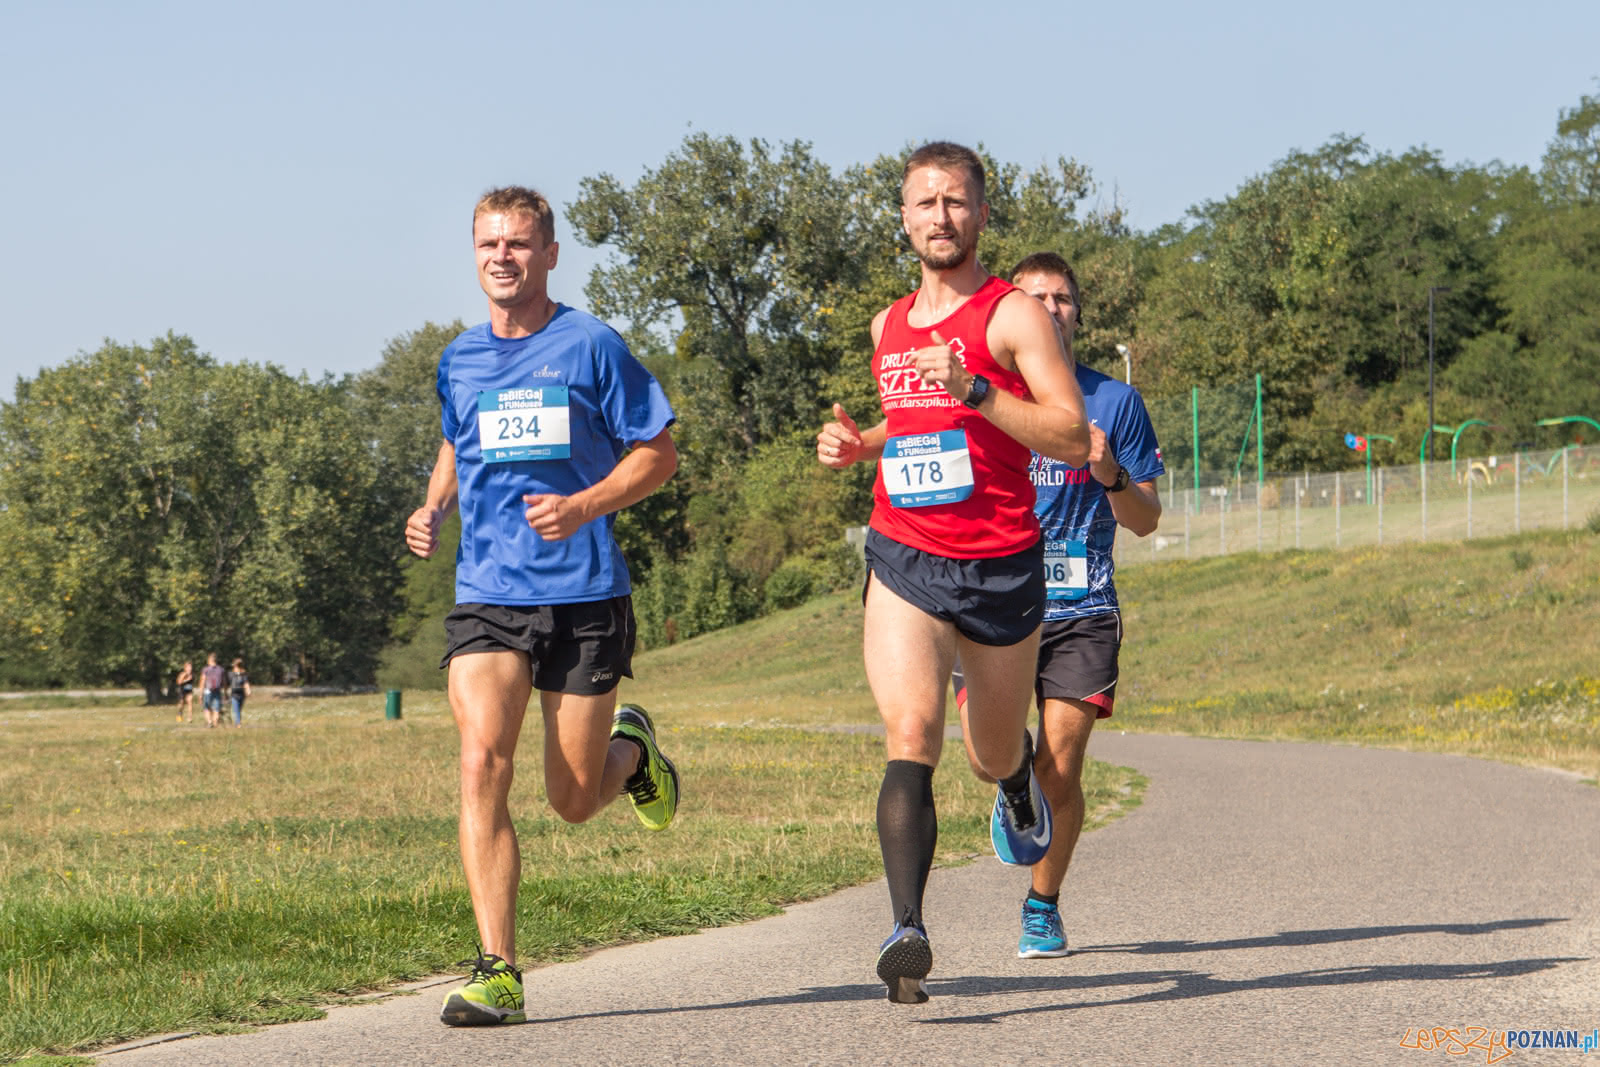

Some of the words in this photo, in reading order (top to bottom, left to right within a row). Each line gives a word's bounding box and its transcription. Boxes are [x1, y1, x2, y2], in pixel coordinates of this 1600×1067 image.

[498, 388, 543, 402] zaBIEGaj
[498, 415, 541, 440] 234
[896, 433, 941, 449] zaBIEGaj
[901, 461, 943, 486] 178
[1044, 563, 1065, 582] 06
